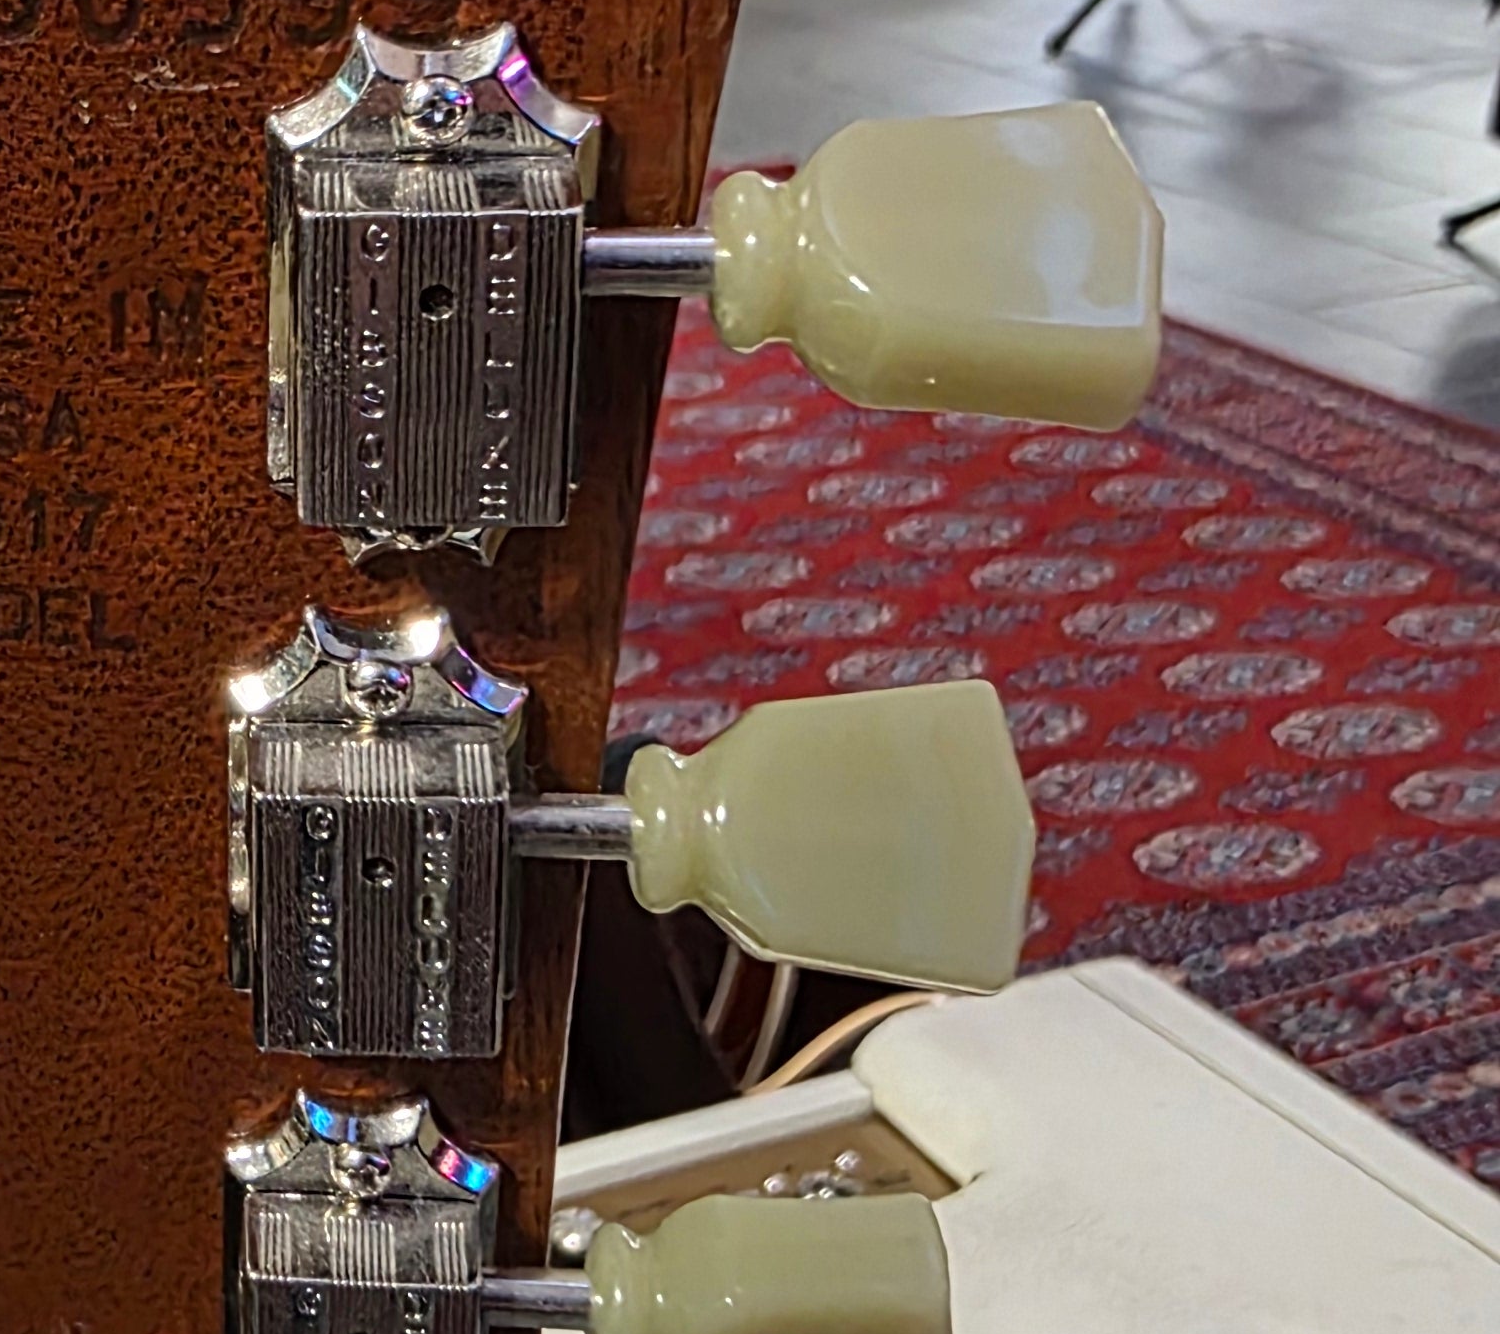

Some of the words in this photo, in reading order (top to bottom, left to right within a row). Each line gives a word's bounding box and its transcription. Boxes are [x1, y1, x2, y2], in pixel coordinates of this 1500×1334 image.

[358, 222, 392, 519] GIBSON
[478, 222, 518, 520] DELUXE
[304, 805, 337, 1051] GIBSON
[414, 807, 452, 1054] DELUXE
